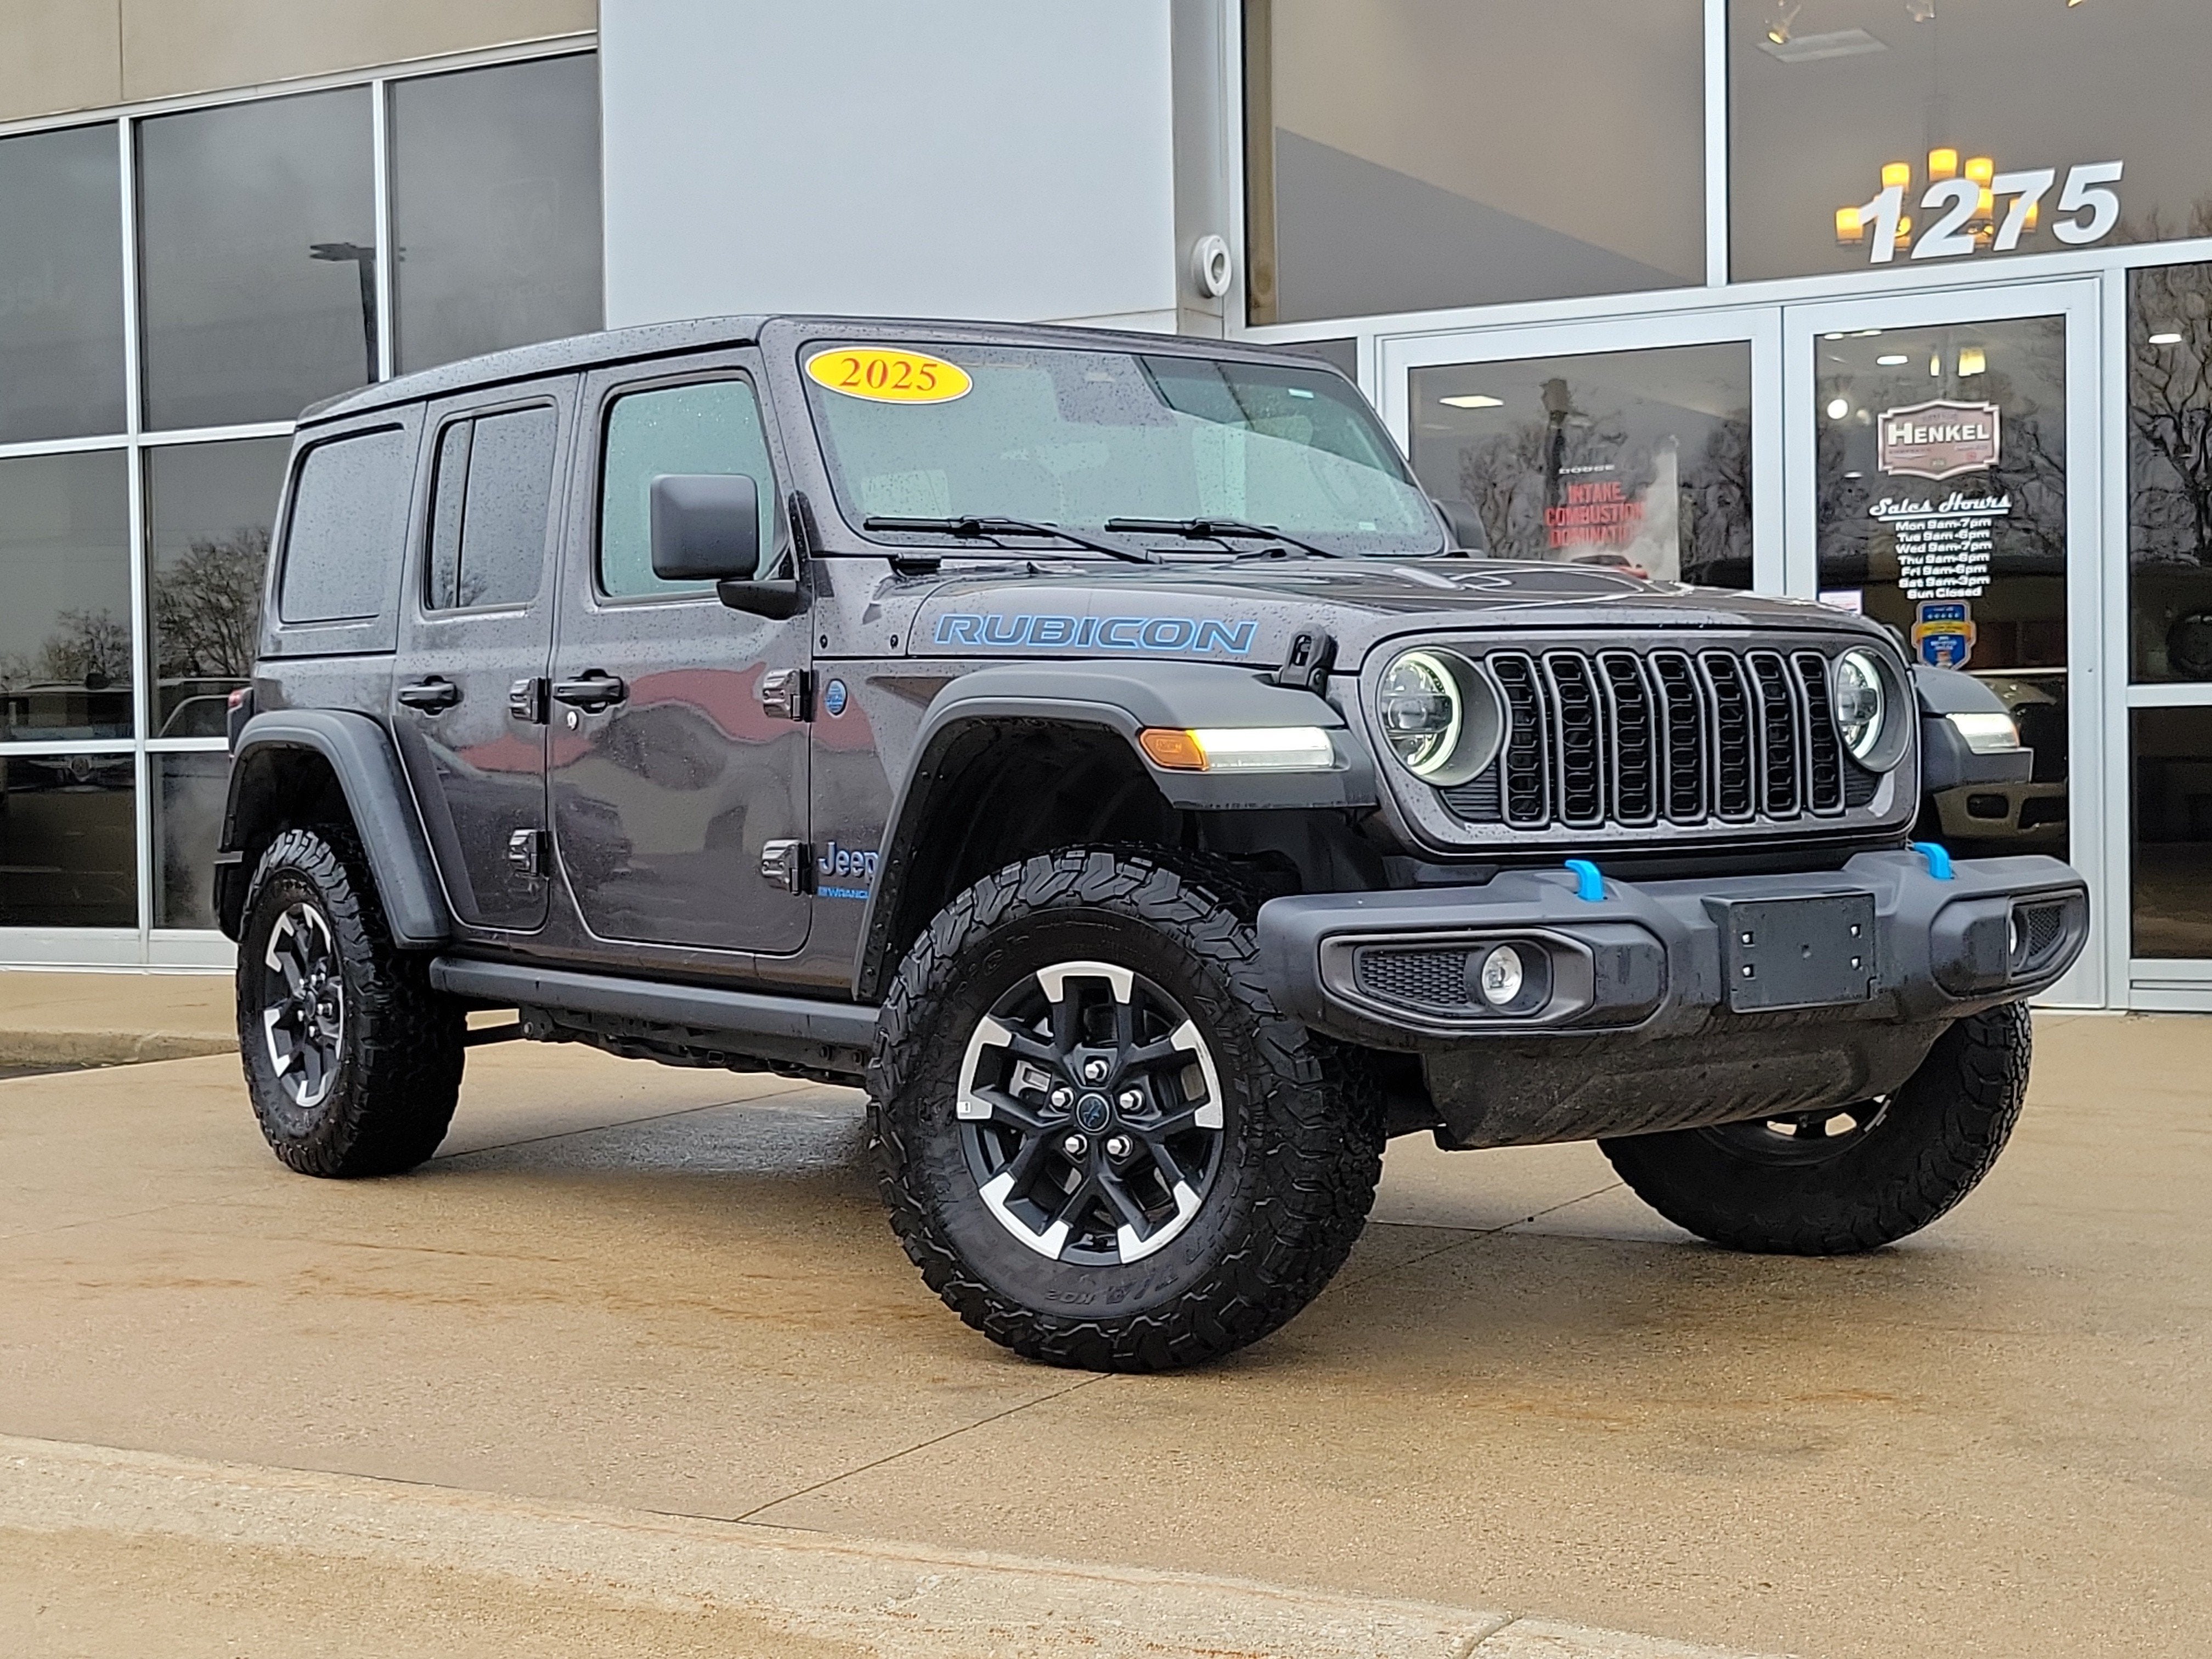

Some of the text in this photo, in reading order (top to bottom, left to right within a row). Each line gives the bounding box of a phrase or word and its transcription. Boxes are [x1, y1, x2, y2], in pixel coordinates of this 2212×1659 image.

[1859, 160, 2124, 264] 1275
[838, 358, 938, 391] 2025
[1888, 422, 1990, 446] HENKEL
[1869, 492, 2012, 516] Sales Hours
[1895, 521, 1925, 531] Mon
[1897, 532, 1921, 542] Tue
[1895, 543, 1926, 554] Wed
[1897, 555, 1923, 565] Thu
[1901, 566, 1921, 576] Fri
[1898, 577, 1924, 588] Sat
[1906, 585, 1983, 599] Sun Closed
[935, 613, 1258, 654] RUBICON
[817, 841, 878, 884] Jeep
